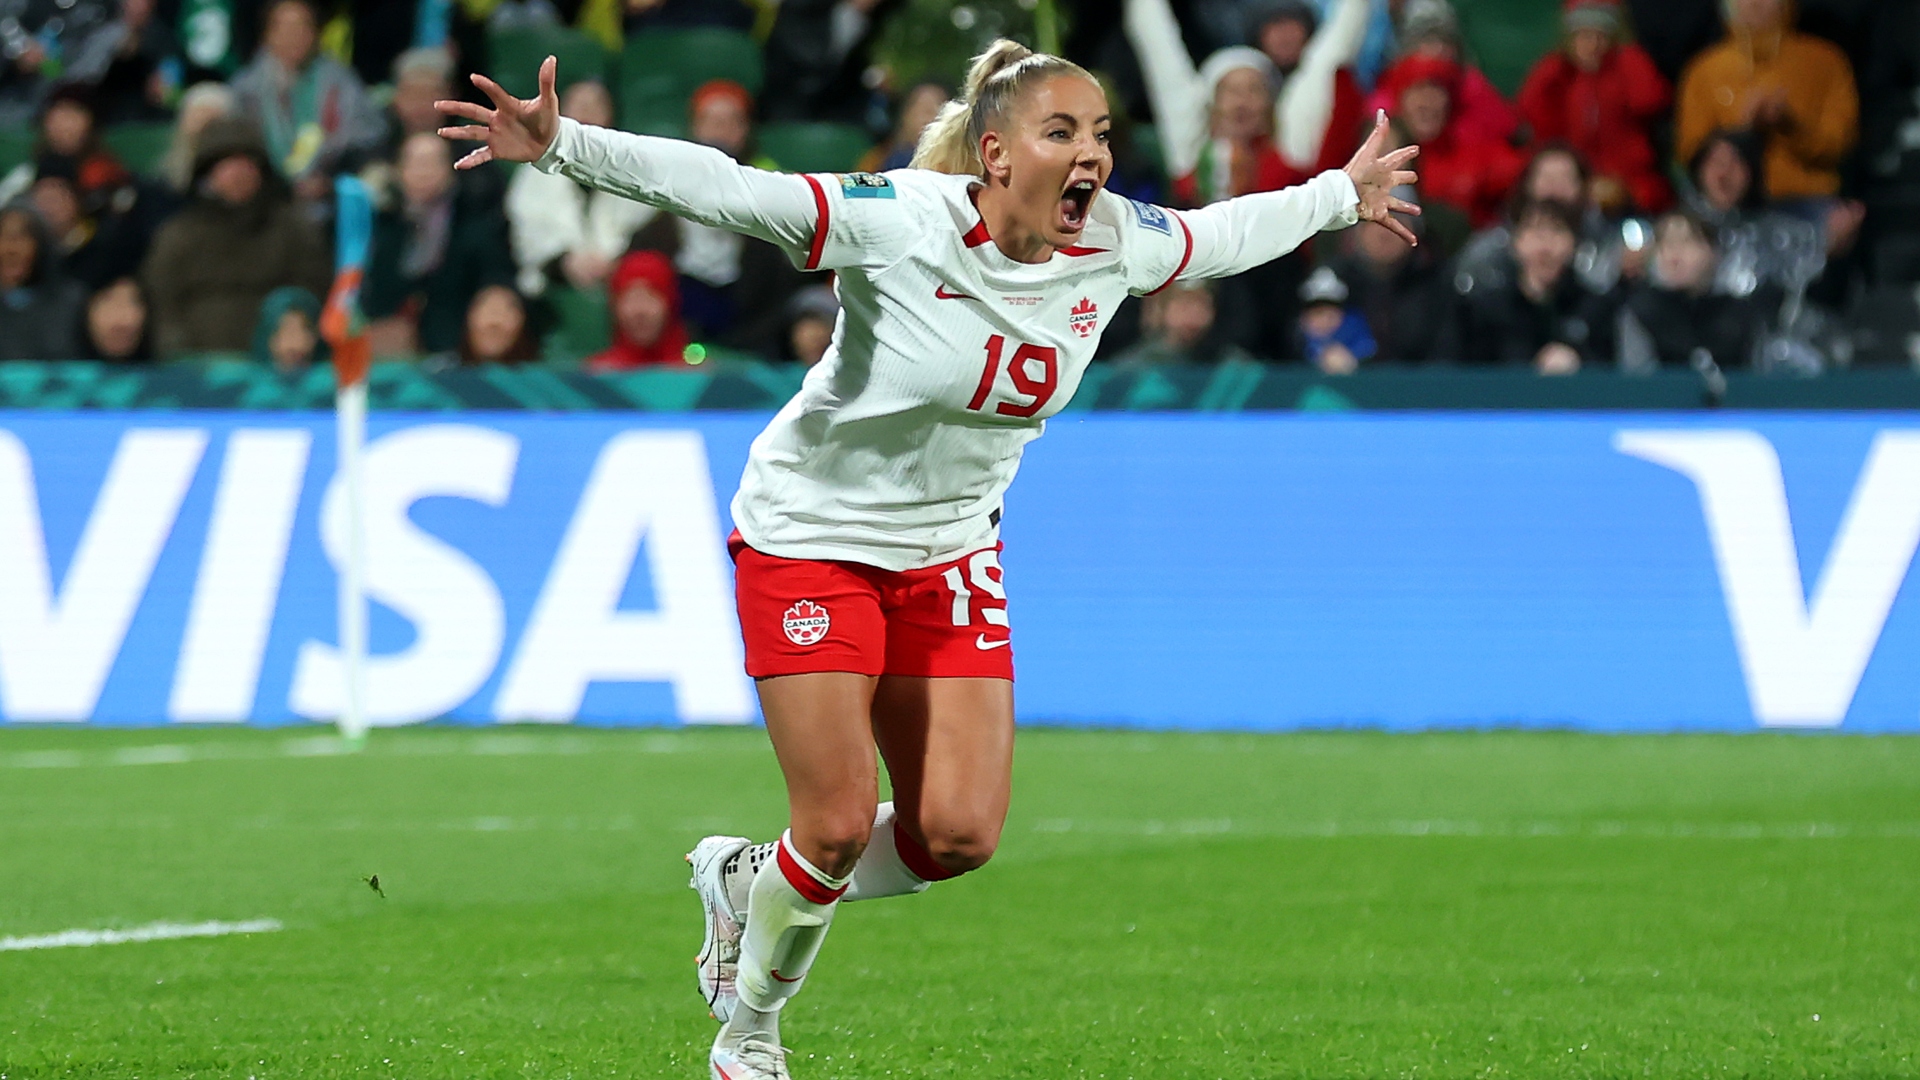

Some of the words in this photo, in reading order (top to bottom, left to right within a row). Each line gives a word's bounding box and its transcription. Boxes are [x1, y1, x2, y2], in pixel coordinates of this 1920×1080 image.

[1069, 313, 1098, 323] CANADA
[966, 334, 1058, 418] 19
[0, 424, 757, 726] VISA
[785, 618, 827, 628] CANADA
